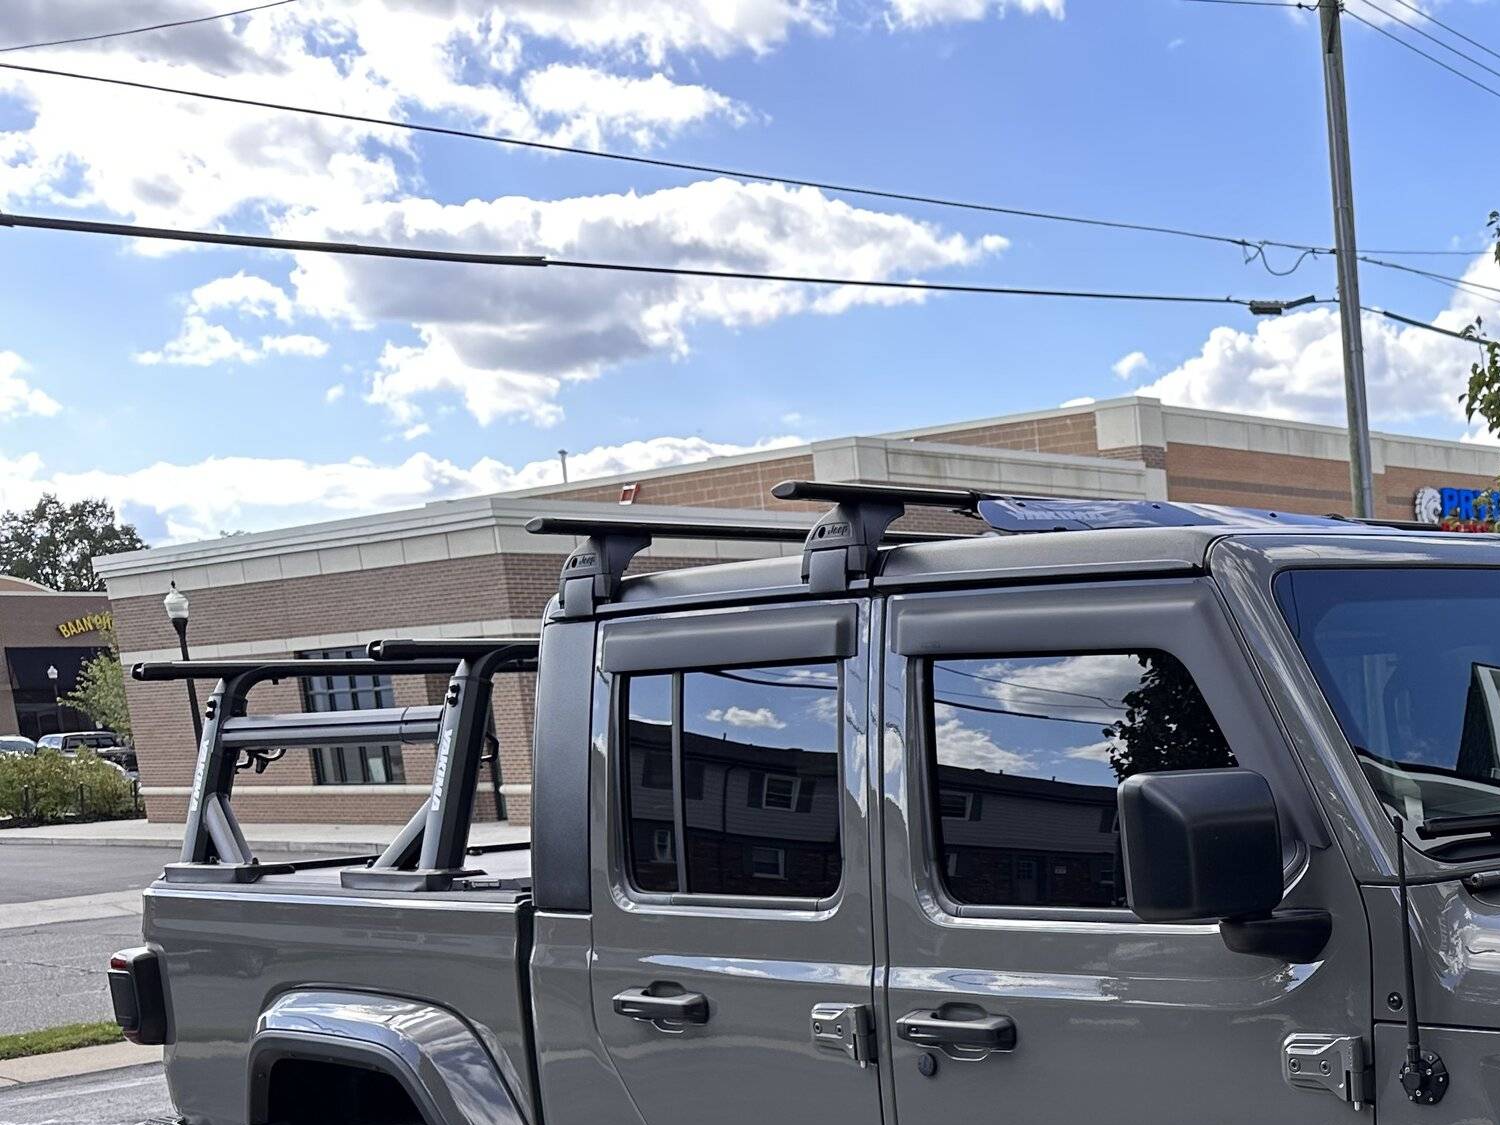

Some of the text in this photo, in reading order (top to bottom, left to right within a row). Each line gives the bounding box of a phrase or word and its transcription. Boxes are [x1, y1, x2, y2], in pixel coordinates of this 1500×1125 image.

[827, 525, 849, 537] Jeep
[578, 554, 597, 567] Jeep
[190, 739, 209, 812] YAKIMA
[432, 729, 452, 811] YAKIMA
